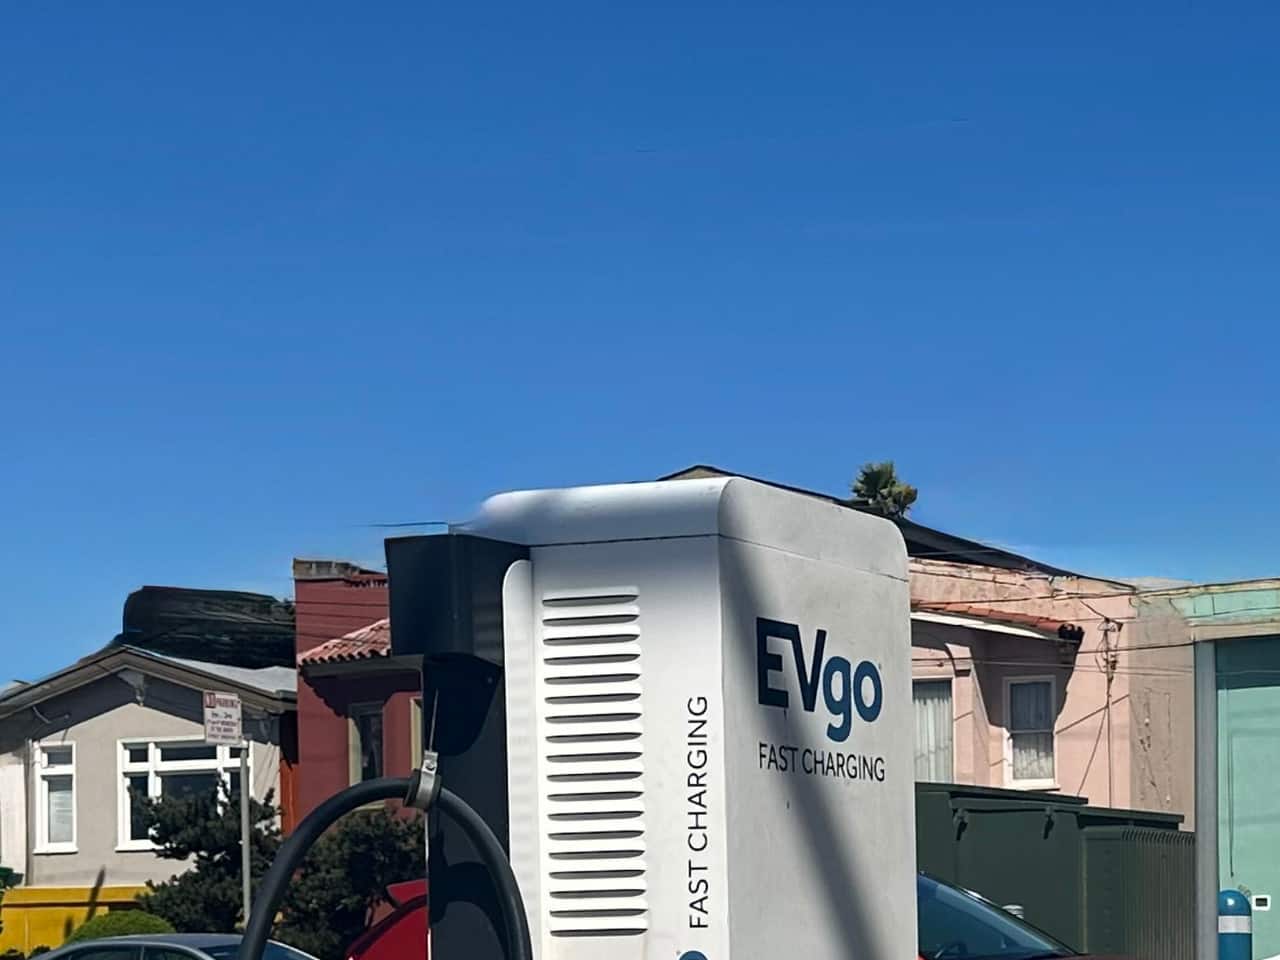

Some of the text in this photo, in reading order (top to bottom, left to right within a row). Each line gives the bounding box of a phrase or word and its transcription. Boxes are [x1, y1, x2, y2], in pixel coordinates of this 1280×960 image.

[756, 616, 883, 743] EVgo
[687, 695, 709, 929] FAST CHARGING
[758, 742, 886, 782] FAST CHARGING
